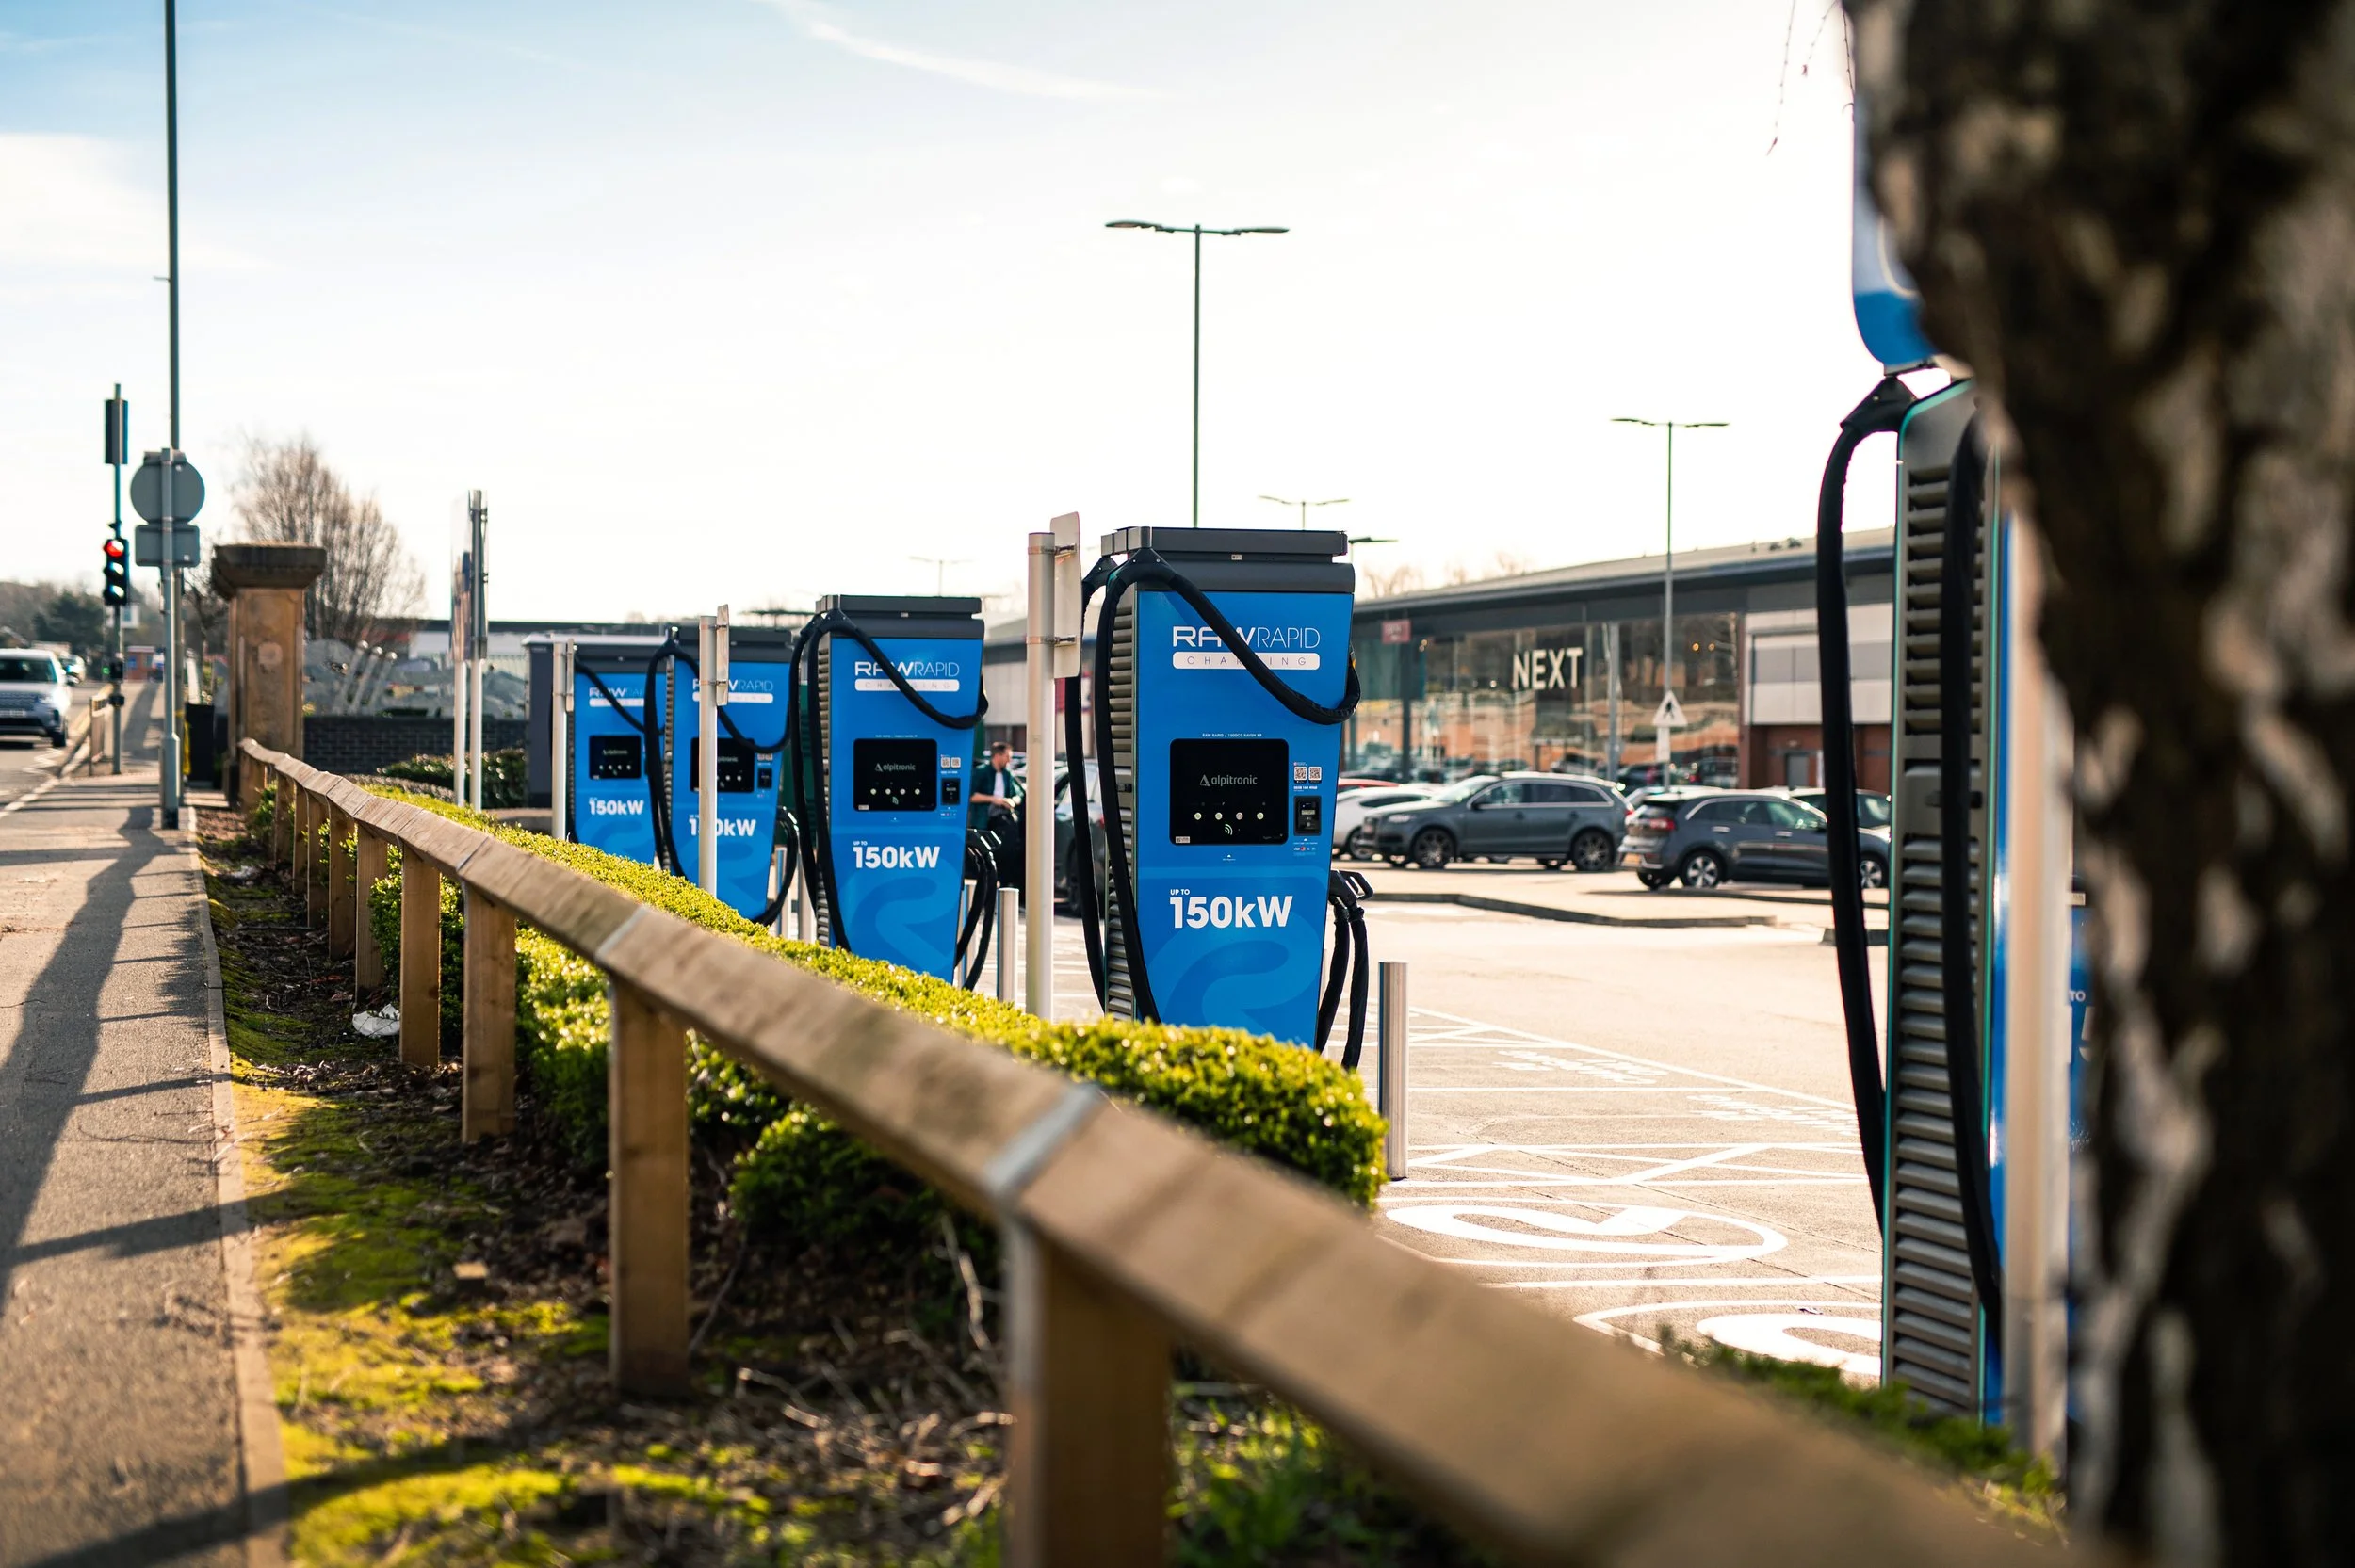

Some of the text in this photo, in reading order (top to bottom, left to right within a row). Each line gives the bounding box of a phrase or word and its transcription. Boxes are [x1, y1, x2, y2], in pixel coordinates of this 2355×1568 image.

[1187, 655, 1307, 666] CHARING
[1512, 647, 1584, 691] NEXT
[1210, 774, 1258, 787] alpitronic
[589, 800, 644, 816] 150kW
[689, 818, 756, 836] 10kW
[853, 846, 941, 868] 150kW
[1169, 896, 1293, 929] 150kW
